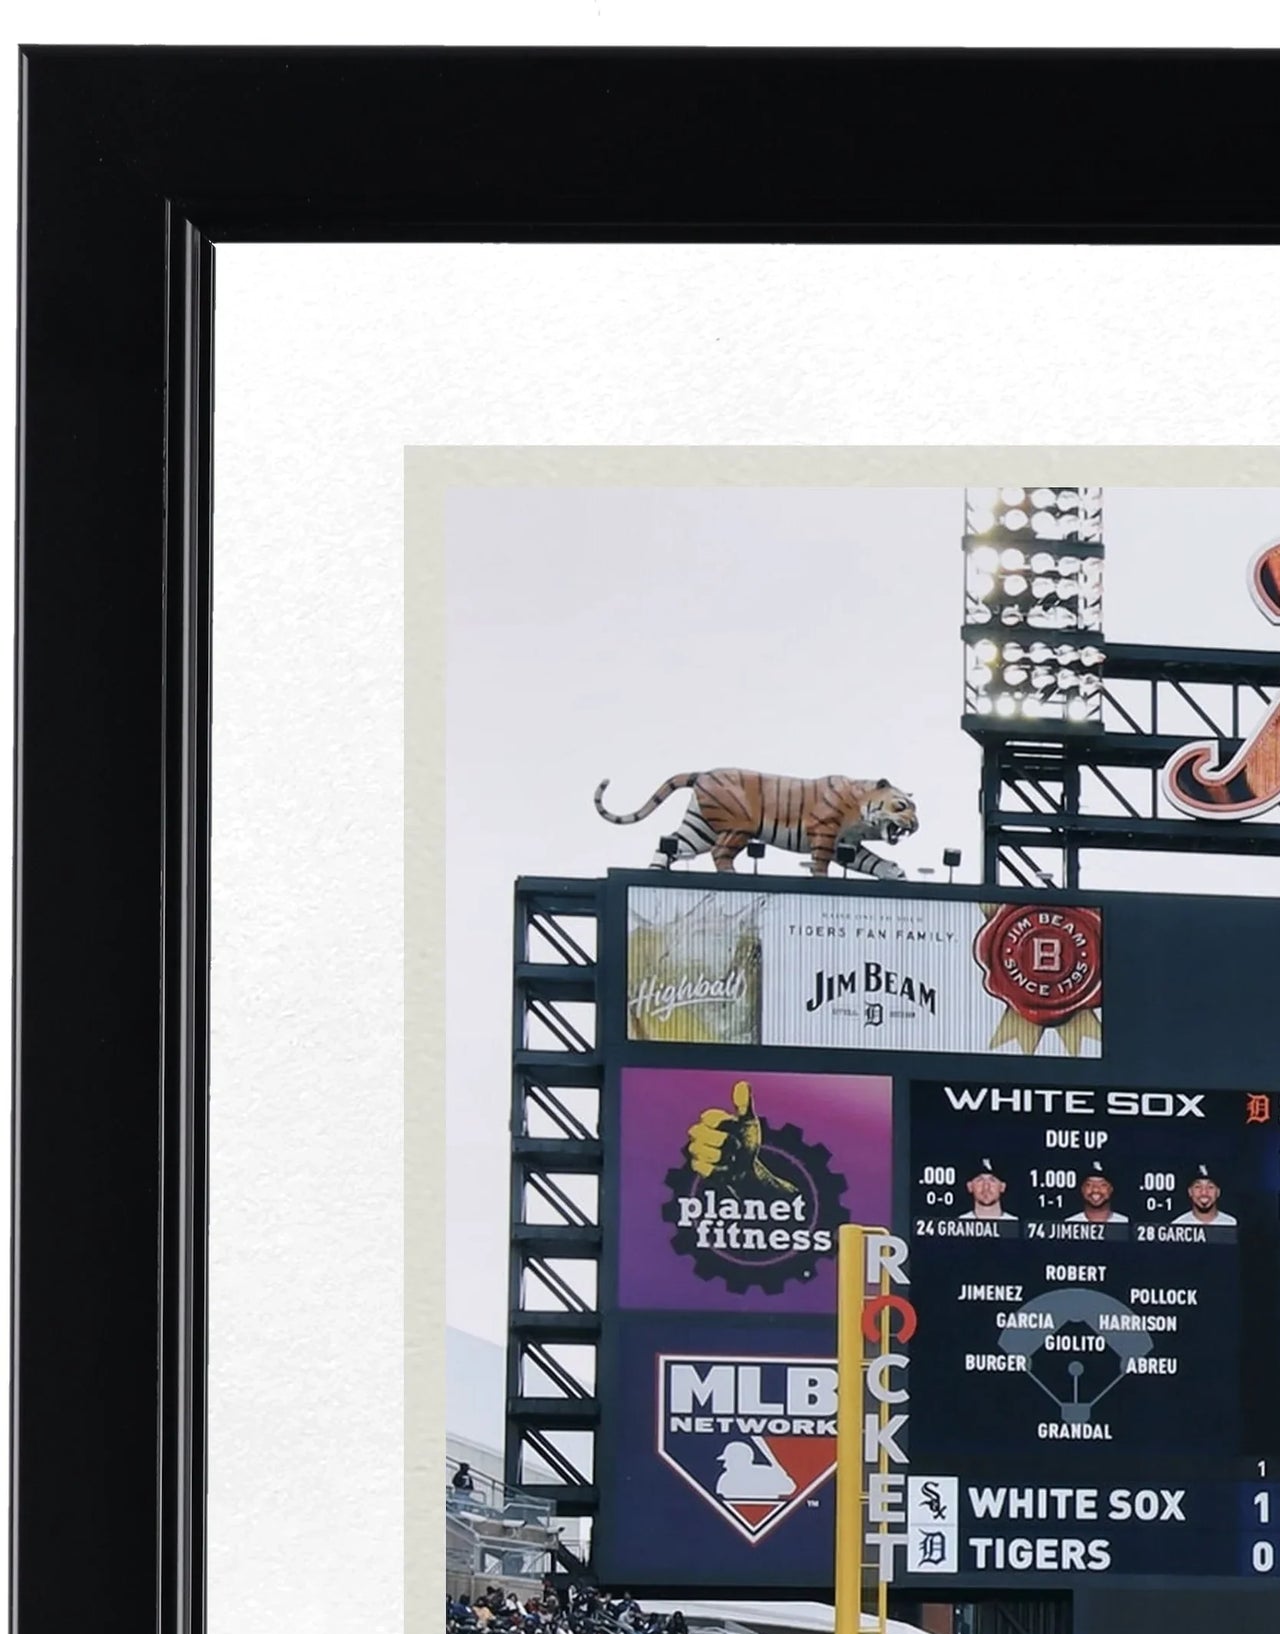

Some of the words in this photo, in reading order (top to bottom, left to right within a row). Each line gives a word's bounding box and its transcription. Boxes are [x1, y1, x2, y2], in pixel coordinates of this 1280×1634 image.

[789, 925, 846, 938] TIGERS
[856, 927, 886, 940] FAN
[1007, 917, 1032, 944] JIM
[1039, 912, 1086, 947] BEAM
[1004, 957, 1050, 996] SINCE
[1058, 961, 1088, 995] 1795
[806, 971, 856, 1012] JIM
[864, 962, 936, 1014] BEAM
[944, 1087, 1095, 1114] WHITE
[1107, 1092, 1206, 1117] SOX
[1046, 1130, 1080, 1148] DUE
[1085, 1131, 1108, 1149] UP
[678, 1192, 806, 1227] planet
[696, 1219, 832, 1251] fitness
[938, 1221, 1000, 1238] GRANDAL
[1048, 1224, 1105, 1240] JIMENEZ
[1158, 1227, 1206, 1243] GARCIA
[1046, 1266, 1107, 1282] ROBERT
[958, 1285, 1023, 1302] JIMENEZ
[1130, 1288, 1198, 1305] POLLOCK
[996, 1313, 1055, 1330] GARCIA
[1099, 1314, 1177, 1332] HARRISON
[1045, 1335, 1105, 1352] GIOLITO
[965, 1355, 1027, 1372] BURGER
[1126, 1358, 1177, 1375] ABREU
[670, 1365, 838, 1415] MLB
[861, 1235, 917, 1583] ROCKET
[670, 1417, 838, 1435] NETWORK
[1037, 1423, 1112, 1440] GRANDAL
[968, 1487, 1098, 1519] WHITE
[1108, 1489, 1186, 1521] SOX
[969, 1538, 1111, 1570] TIGERS
